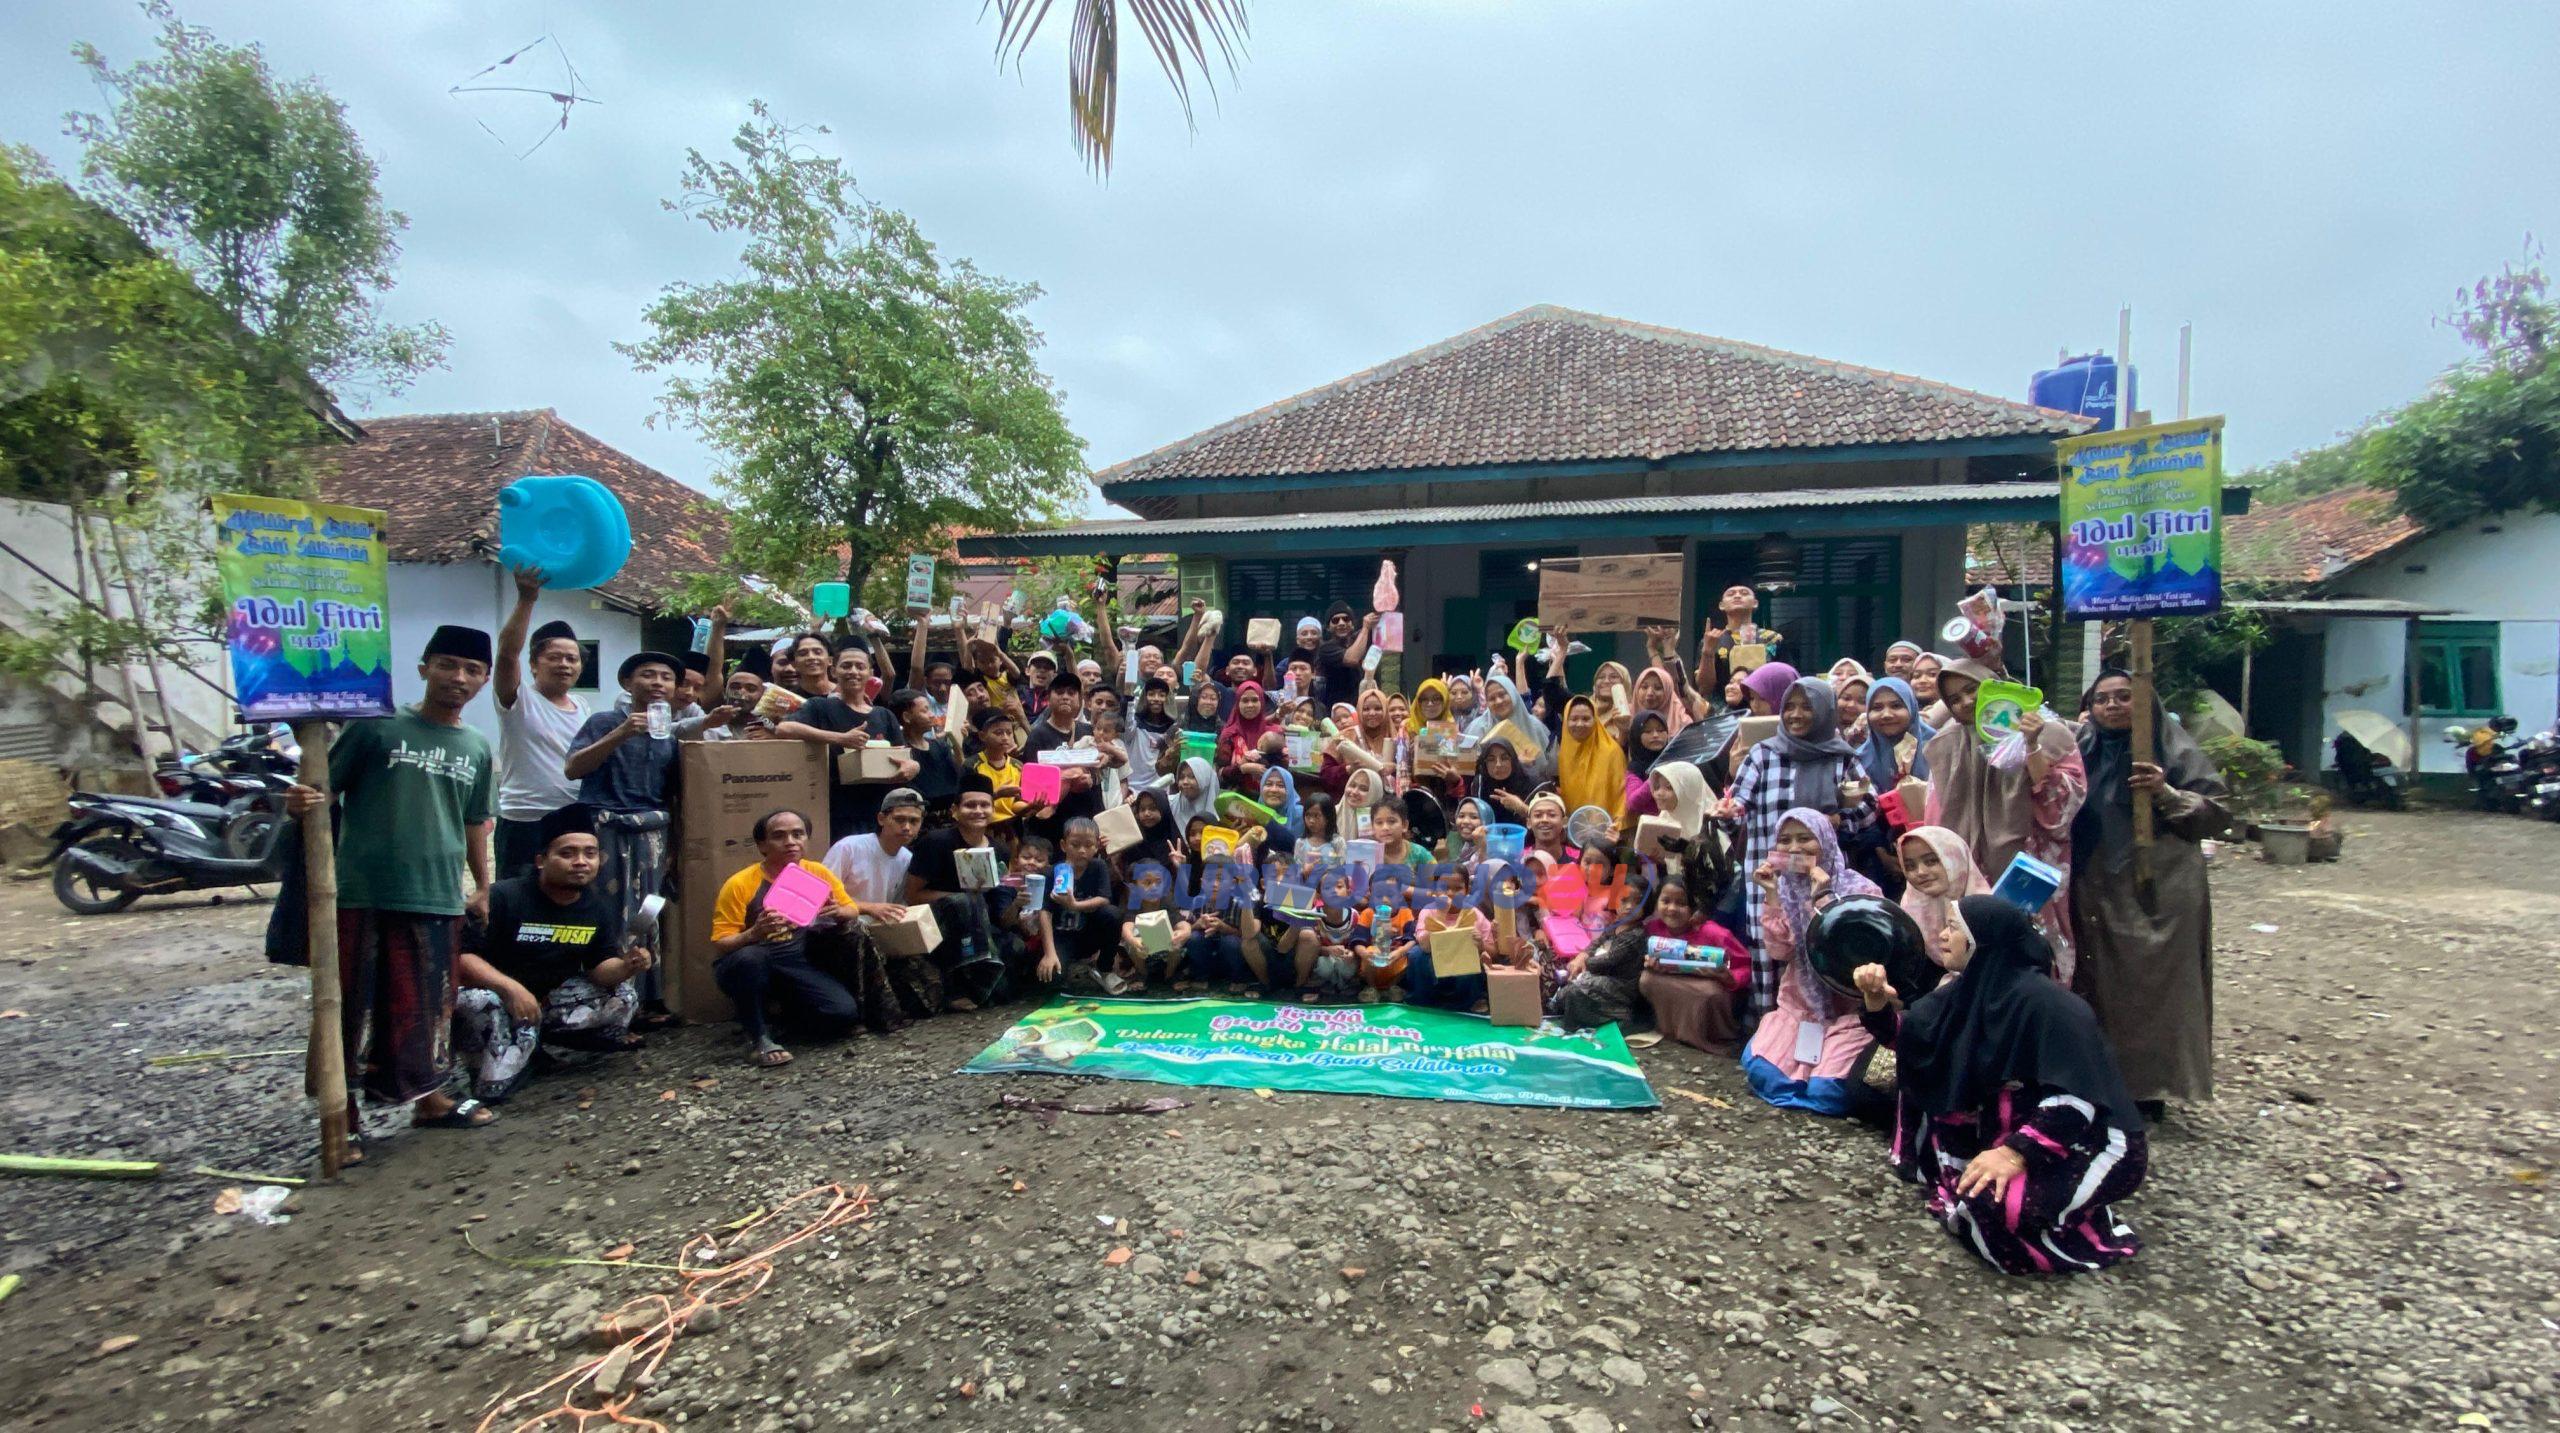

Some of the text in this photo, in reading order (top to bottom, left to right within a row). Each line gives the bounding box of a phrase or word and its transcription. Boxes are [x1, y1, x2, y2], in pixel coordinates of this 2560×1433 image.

[2072, 508, 2210, 543] Idul Fitri
[237, 597, 382, 630] Idul Fitri
[722, 773, 793, 784] Panasonic
[551, 929, 595, 944] PUSAT
[1115, 1028, 1199, 1040] Dalam
[1207, 1030, 1307, 1049] Rangka
[1312, 1036, 1390, 1055] Halal
[1437, 1042, 1516, 1061] Halal
[1304, 1051, 1376, 1067] Bani
[1378, 1055, 1507, 1075] Sulaiman
